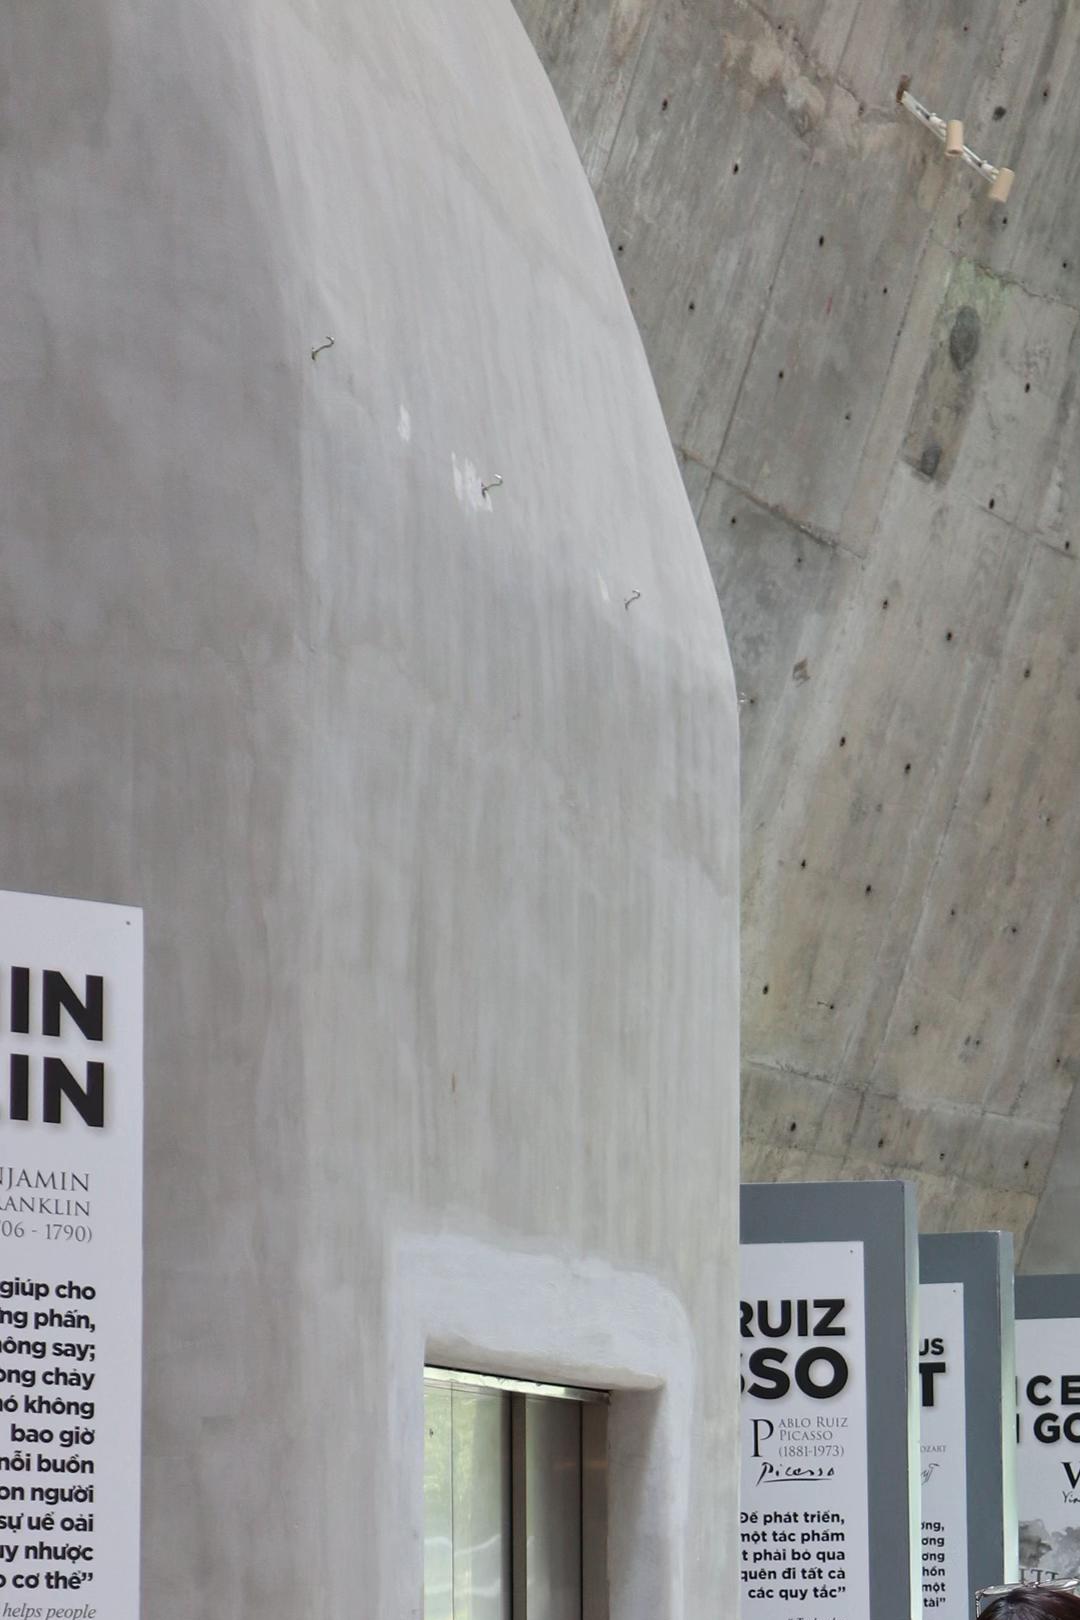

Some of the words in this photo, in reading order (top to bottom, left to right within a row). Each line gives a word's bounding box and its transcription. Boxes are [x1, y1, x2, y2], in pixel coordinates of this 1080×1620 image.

[11, 966, 103, 1041] IN
[10, 1053, 104, 1128] IN
[0, 1167, 90, 1192] JAMIN
[0, 1196, 90, 1216] ANKLIN
[0, 1220, 25, 1238] 06
[46, 1223, 92, 1243] 1790)
[0, 1277, 50, 1300] giúp
[55, 1281, 96, 1300] cho
[0, 1308, 28, 1329] ng
[34, 1308, 96, 1333] phấn,
[0, 1336, 46, 1359] ông
[52, 1343, 95, 1361] say;
[42, 1367, 95, 1390] chảy
[741, 1346, 848, 1400] SO
[0, 1395, 19, 1412] ó
[24, 1394, 95, 1420] không
[817, 1416, 849, 1428] RUIZ
[11, 1423, 54, 1443] bao
[59, 1426, 95, 1448] giờ
[780, 1430, 833, 1441] PICASSO
[37, 1453, 94, 1474] buồn
[31, 1485, 94, 1505] người
[60, 1514, 94, 1532] oải
[763, 1511, 799, 1526] phát
[772, 1531, 796, 1542] tác
[24, 1541, 94, 1564] nhược
[753, 1549, 786, 1563] phải
[816, 1551, 845, 1563] qua
[12, 1572, 39, 1589] cơ
[782, 1567, 796, 1580] đi
[748, 1587, 774, 1599] các
[779, 1589, 808, 1601] quy
